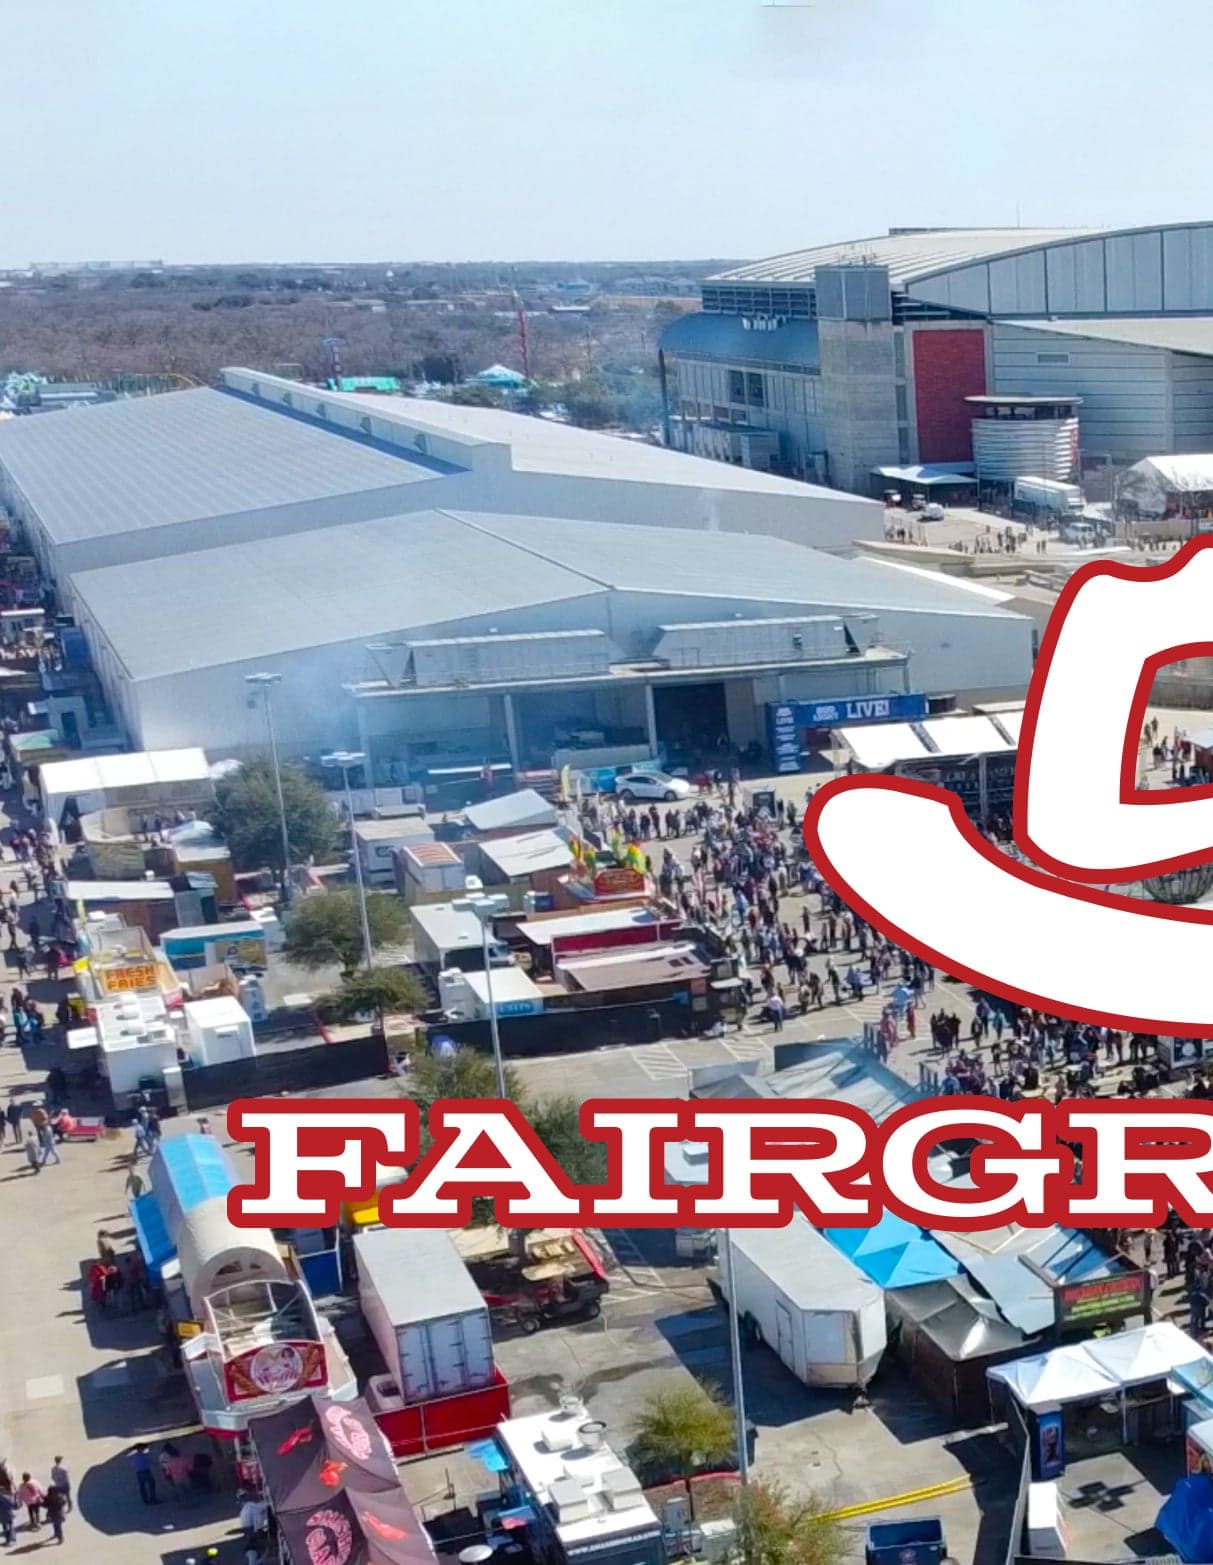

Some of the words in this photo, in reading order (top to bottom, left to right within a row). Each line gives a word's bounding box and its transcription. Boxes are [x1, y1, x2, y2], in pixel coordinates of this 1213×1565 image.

[847, 700, 889, 718] LIVE!
[106, 965, 154, 979] FRESH
[107, 976, 156, 990] FRIES
